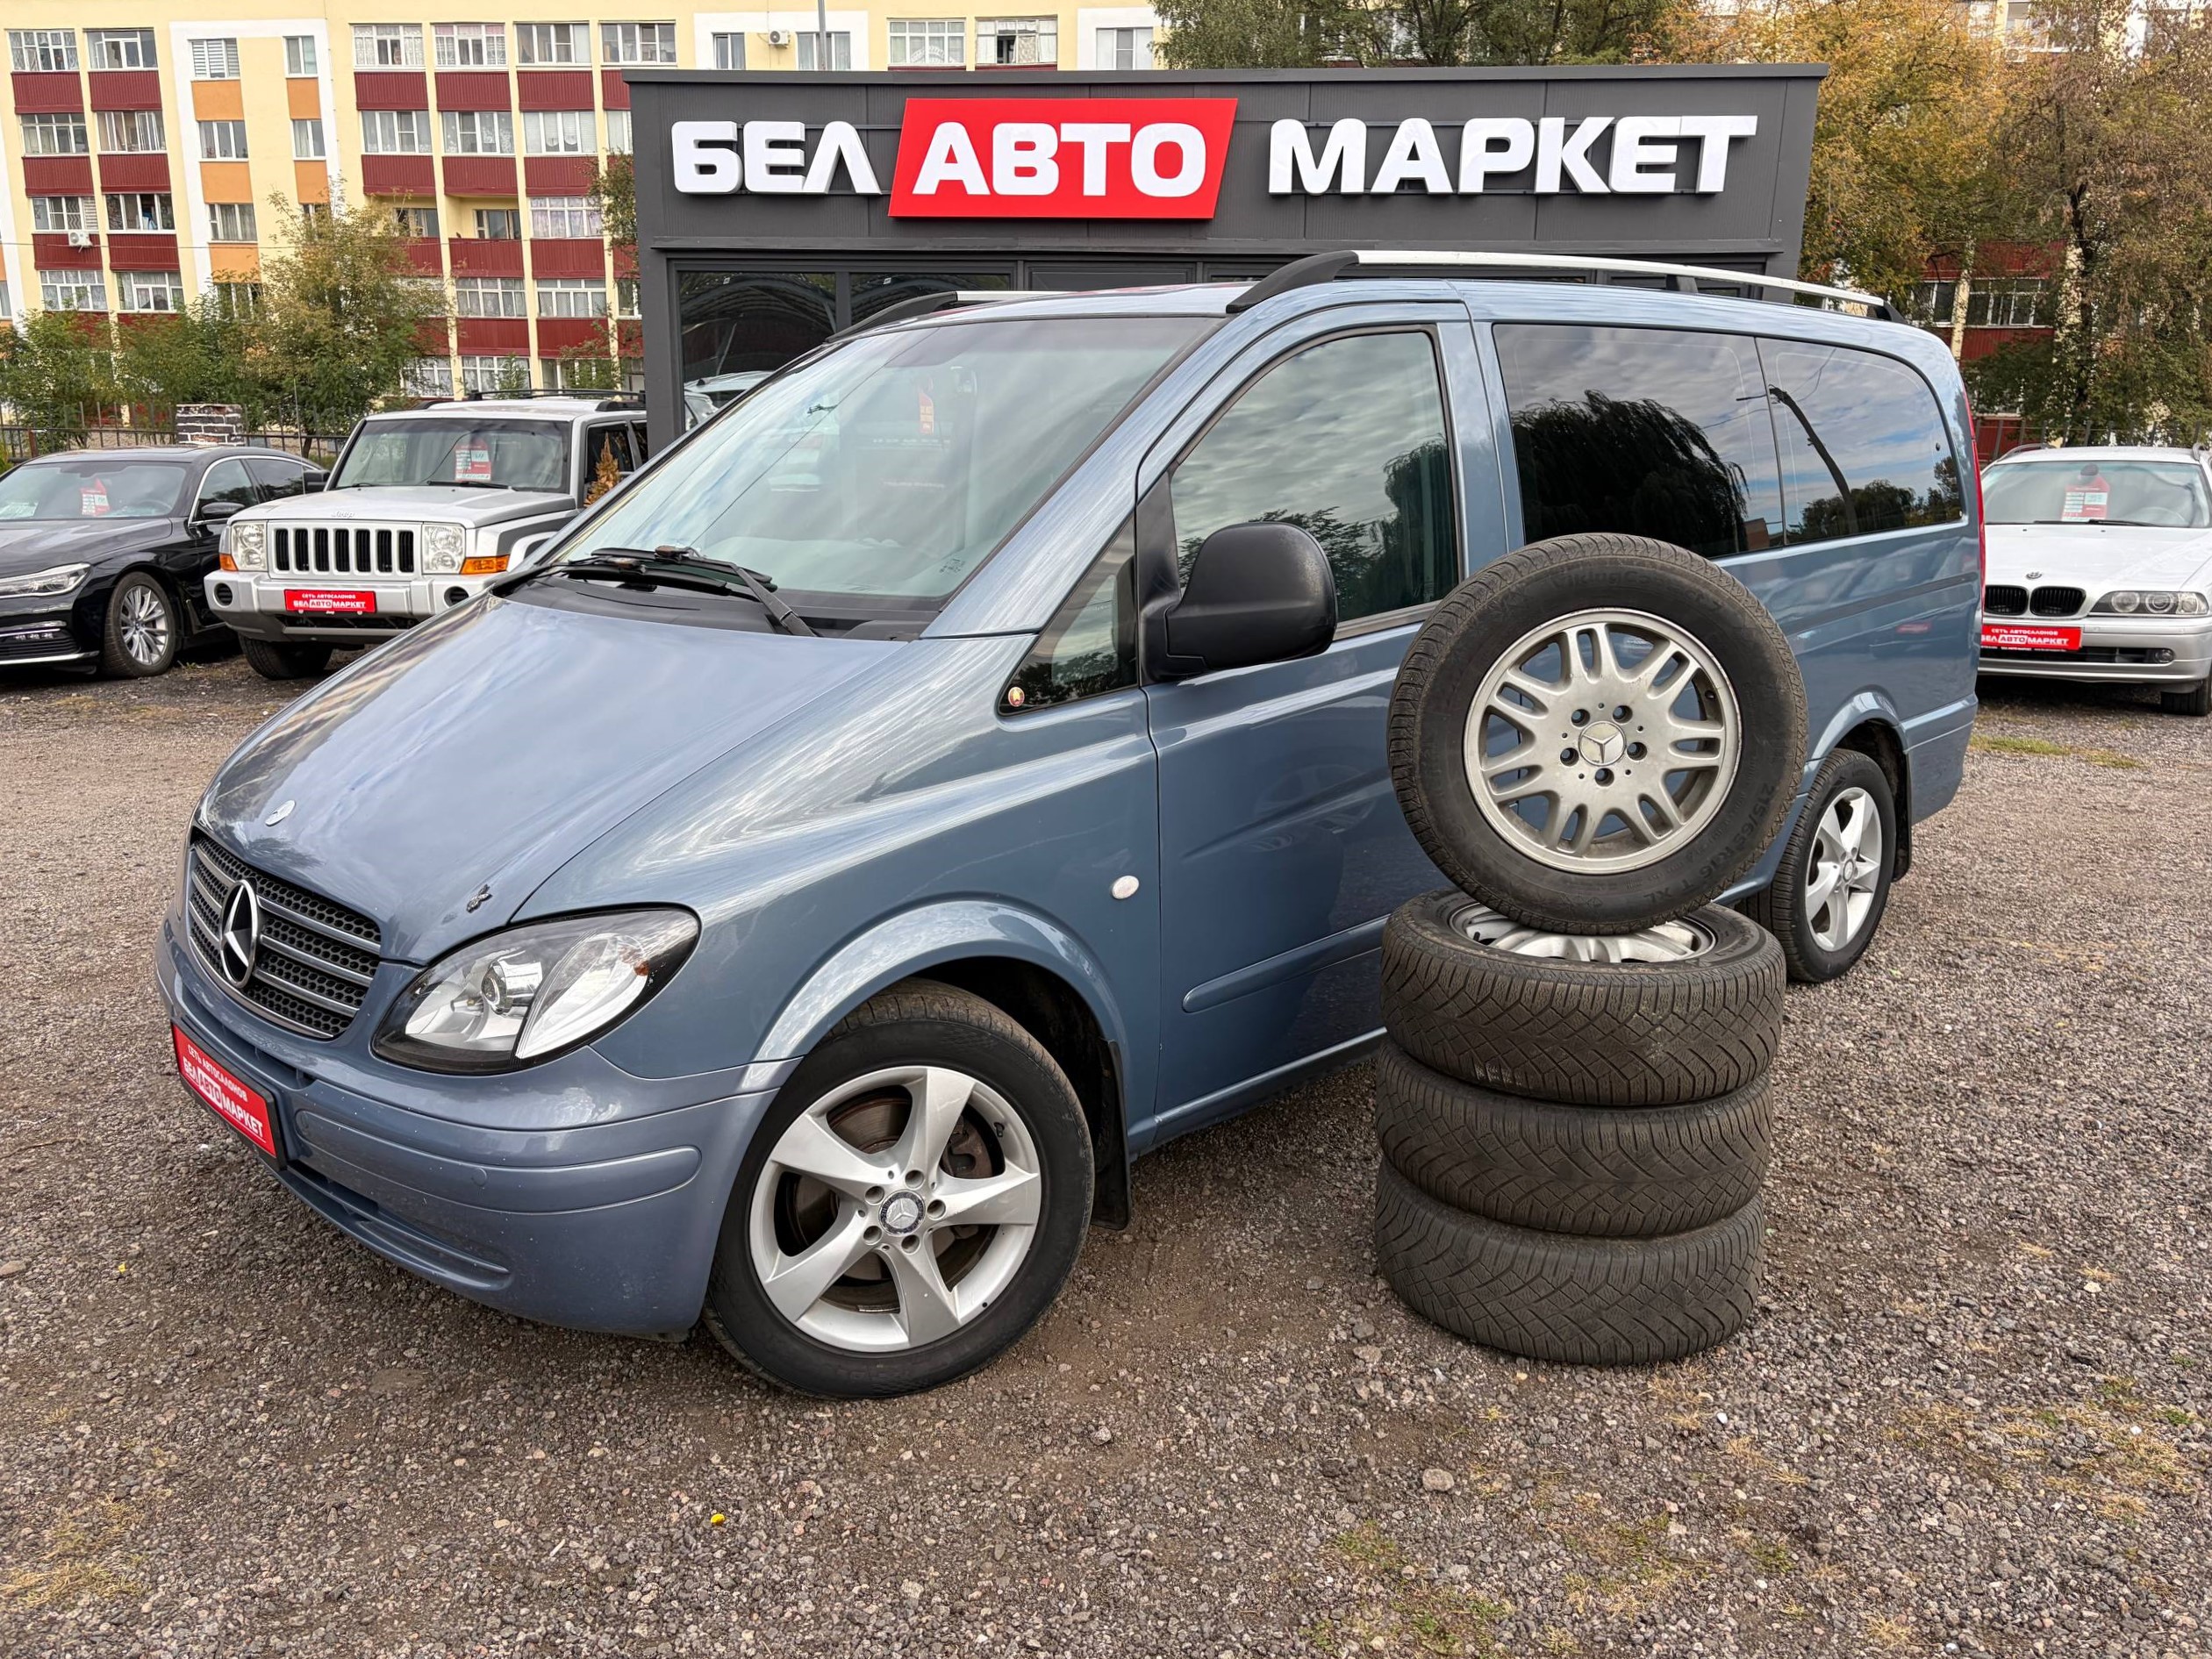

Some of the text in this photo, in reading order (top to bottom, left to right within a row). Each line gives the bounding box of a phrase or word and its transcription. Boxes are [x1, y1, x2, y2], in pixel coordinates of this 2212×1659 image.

[672, 115, 1758, 197] БЕЛ АВТО МАРКЕТ
[183, 1055, 263, 1138] БЕЛ АВТО МАРКЕТ
[188, 1043, 248, 1103] СЕТЬ АВТОСАЛОНОВ
